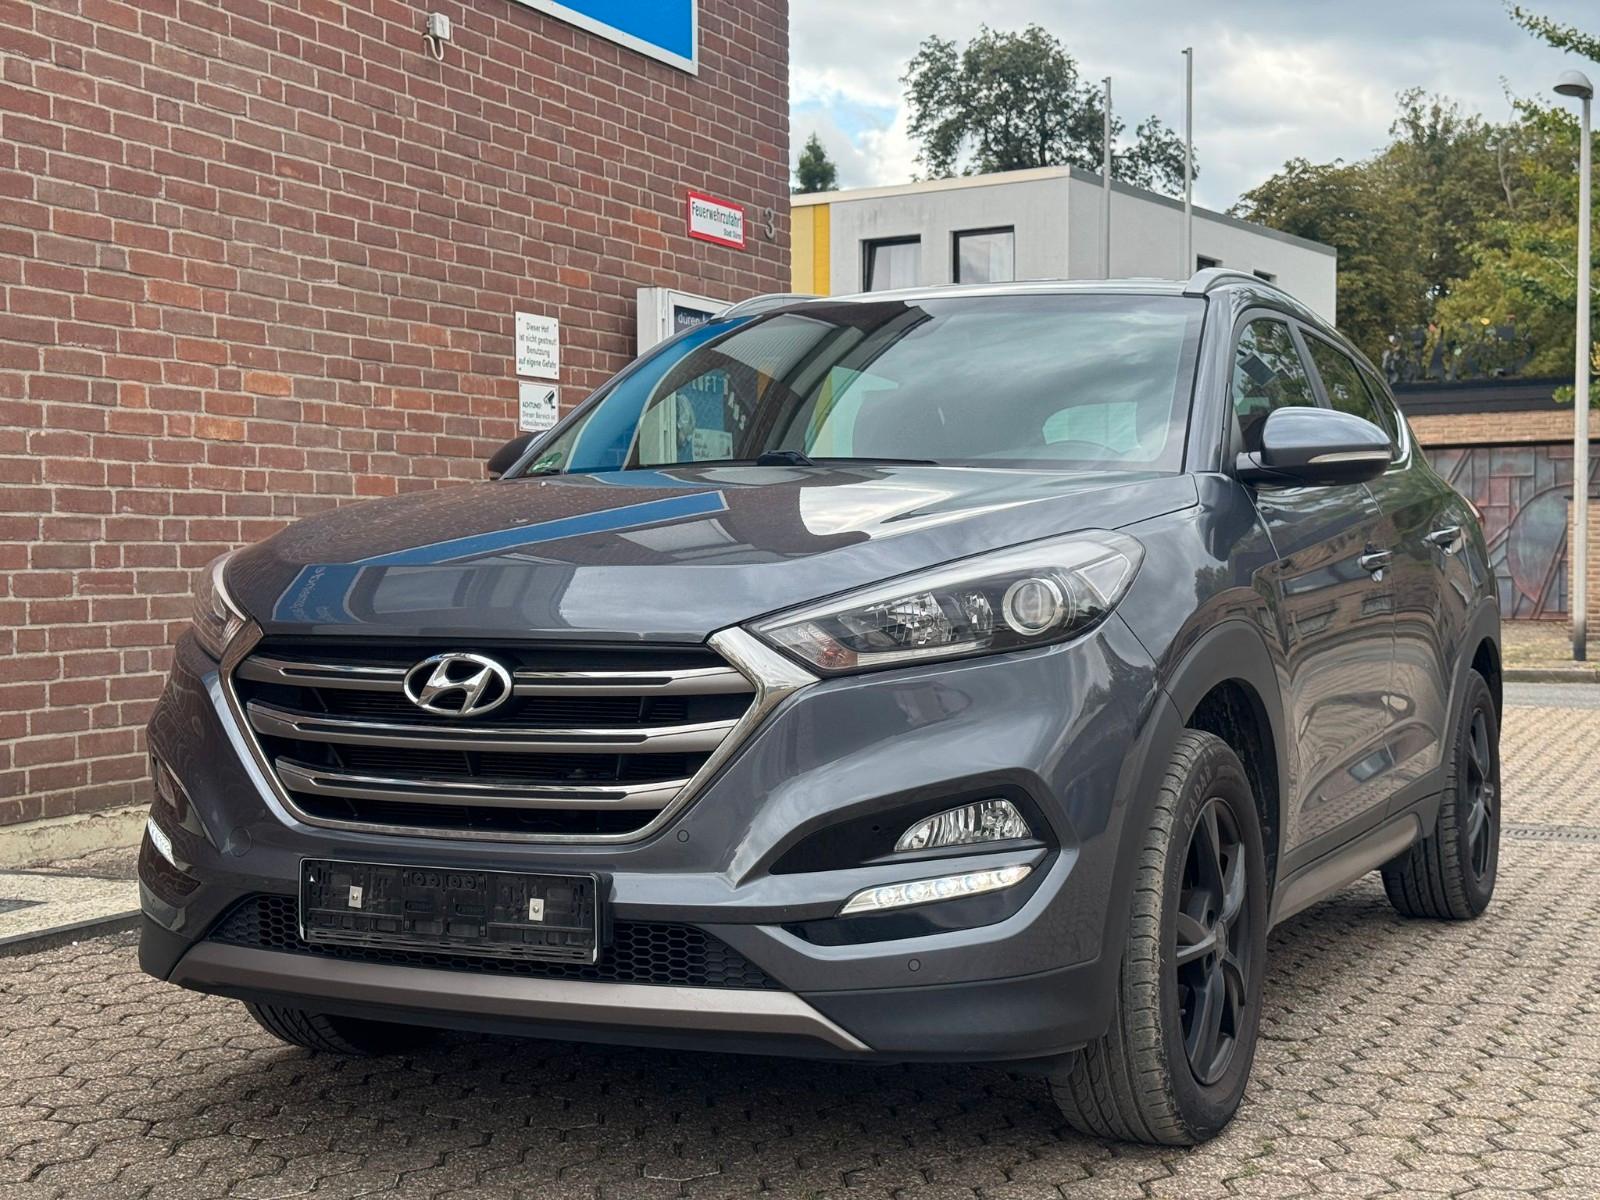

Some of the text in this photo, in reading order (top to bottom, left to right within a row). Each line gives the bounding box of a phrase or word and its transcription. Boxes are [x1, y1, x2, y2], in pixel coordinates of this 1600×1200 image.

[692, 201, 742, 228] Feuerwehrzufahrt
[763, 207, 776, 240] 3
[526, 322, 540, 332] Dieser
[526, 334, 537, 343] nicht
[526, 345, 550, 359] Benutzung
[518, 357, 526, 365] auf
[526, 358, 541, 368] eigene
[1183, 765, 1213, 832] RADAR
